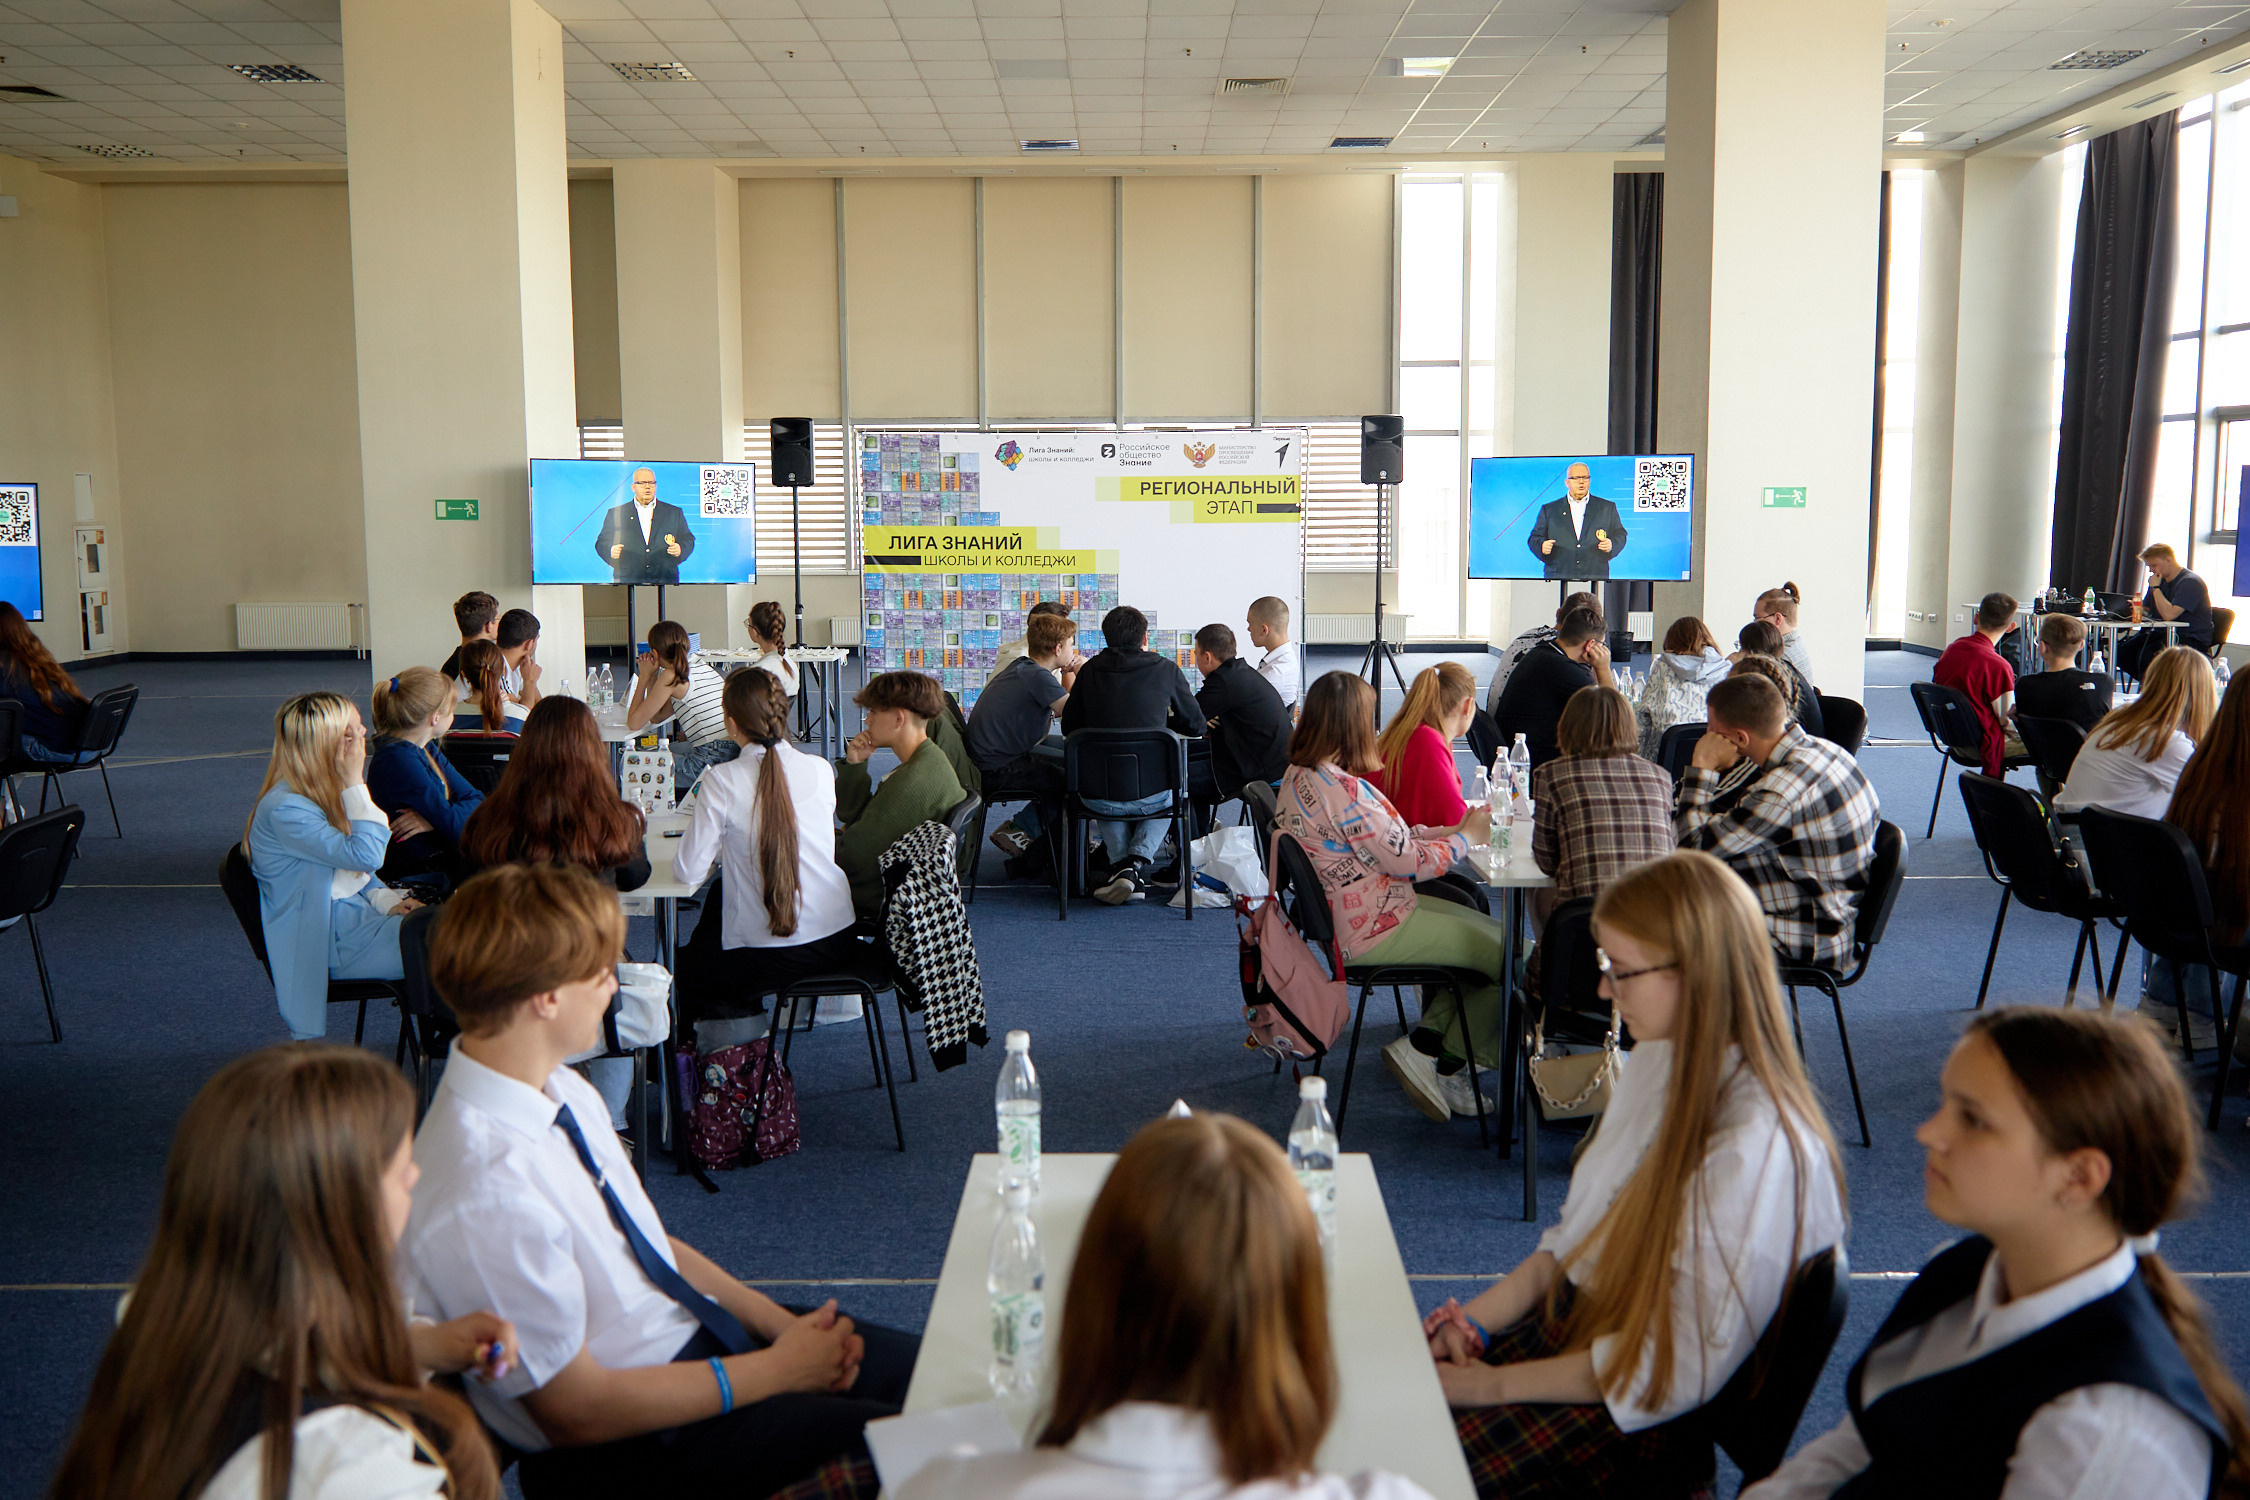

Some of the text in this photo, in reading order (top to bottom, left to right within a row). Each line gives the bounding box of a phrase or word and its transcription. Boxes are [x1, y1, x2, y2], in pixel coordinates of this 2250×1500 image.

[1119, 443, 1170, 451] Российское
[1119, 452, 1162, 460] общество
[1140, 476, 1295, 495] РЕГИОНАЛЬНЫЙ
[1206, 500, 1253, 515] ЭТАП
[888, 533, 1022, 550] ЛИГА ЗНАНИЙ
[924, 555, 1076, 568] ШКОЛЫ И КОЛЛЕДЖИ
[1327, 857, 1353, 878] SPEED
